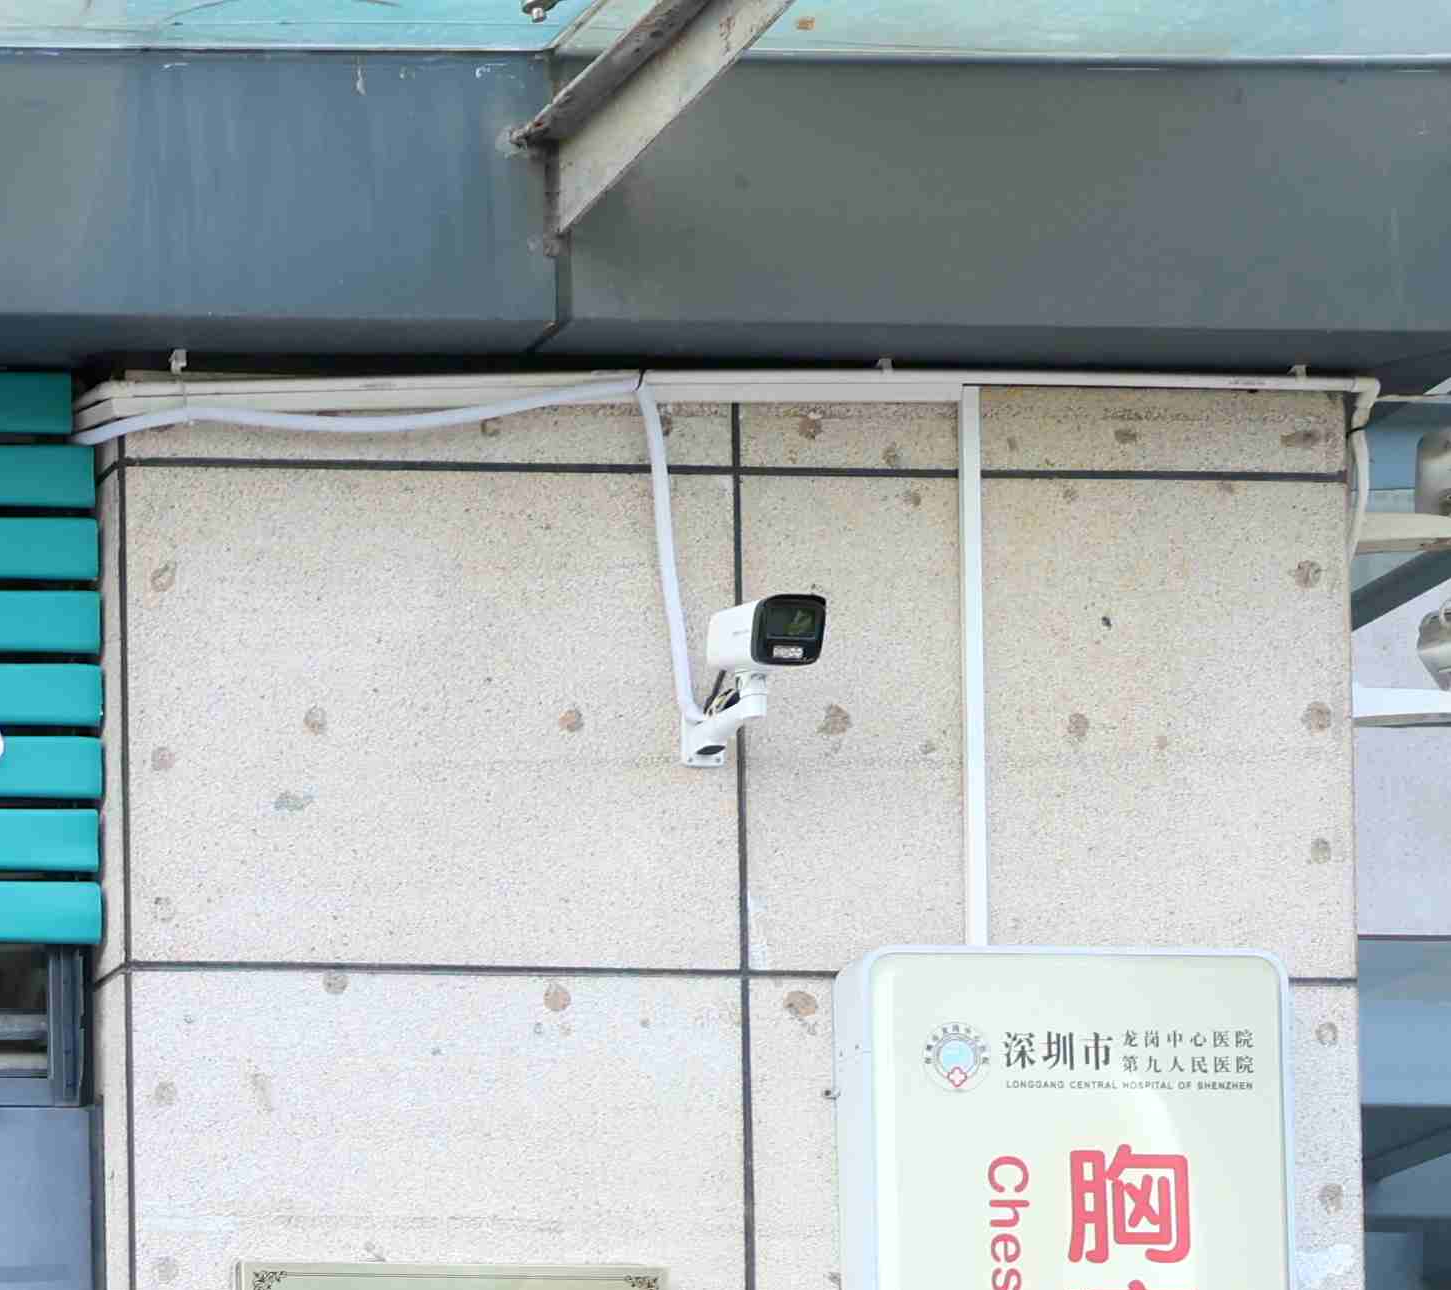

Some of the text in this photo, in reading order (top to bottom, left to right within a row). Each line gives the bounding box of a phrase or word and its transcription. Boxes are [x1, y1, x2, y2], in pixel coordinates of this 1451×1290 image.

[1121, 1028, 1255, 1050] 龙岗中心医院
[1003, 1030, 1114, 1071] 深圳市
[1121, 1055, 1255, 1075] 第九人民医院
[1069, 1080, 1118, 1090] CENTRAL
